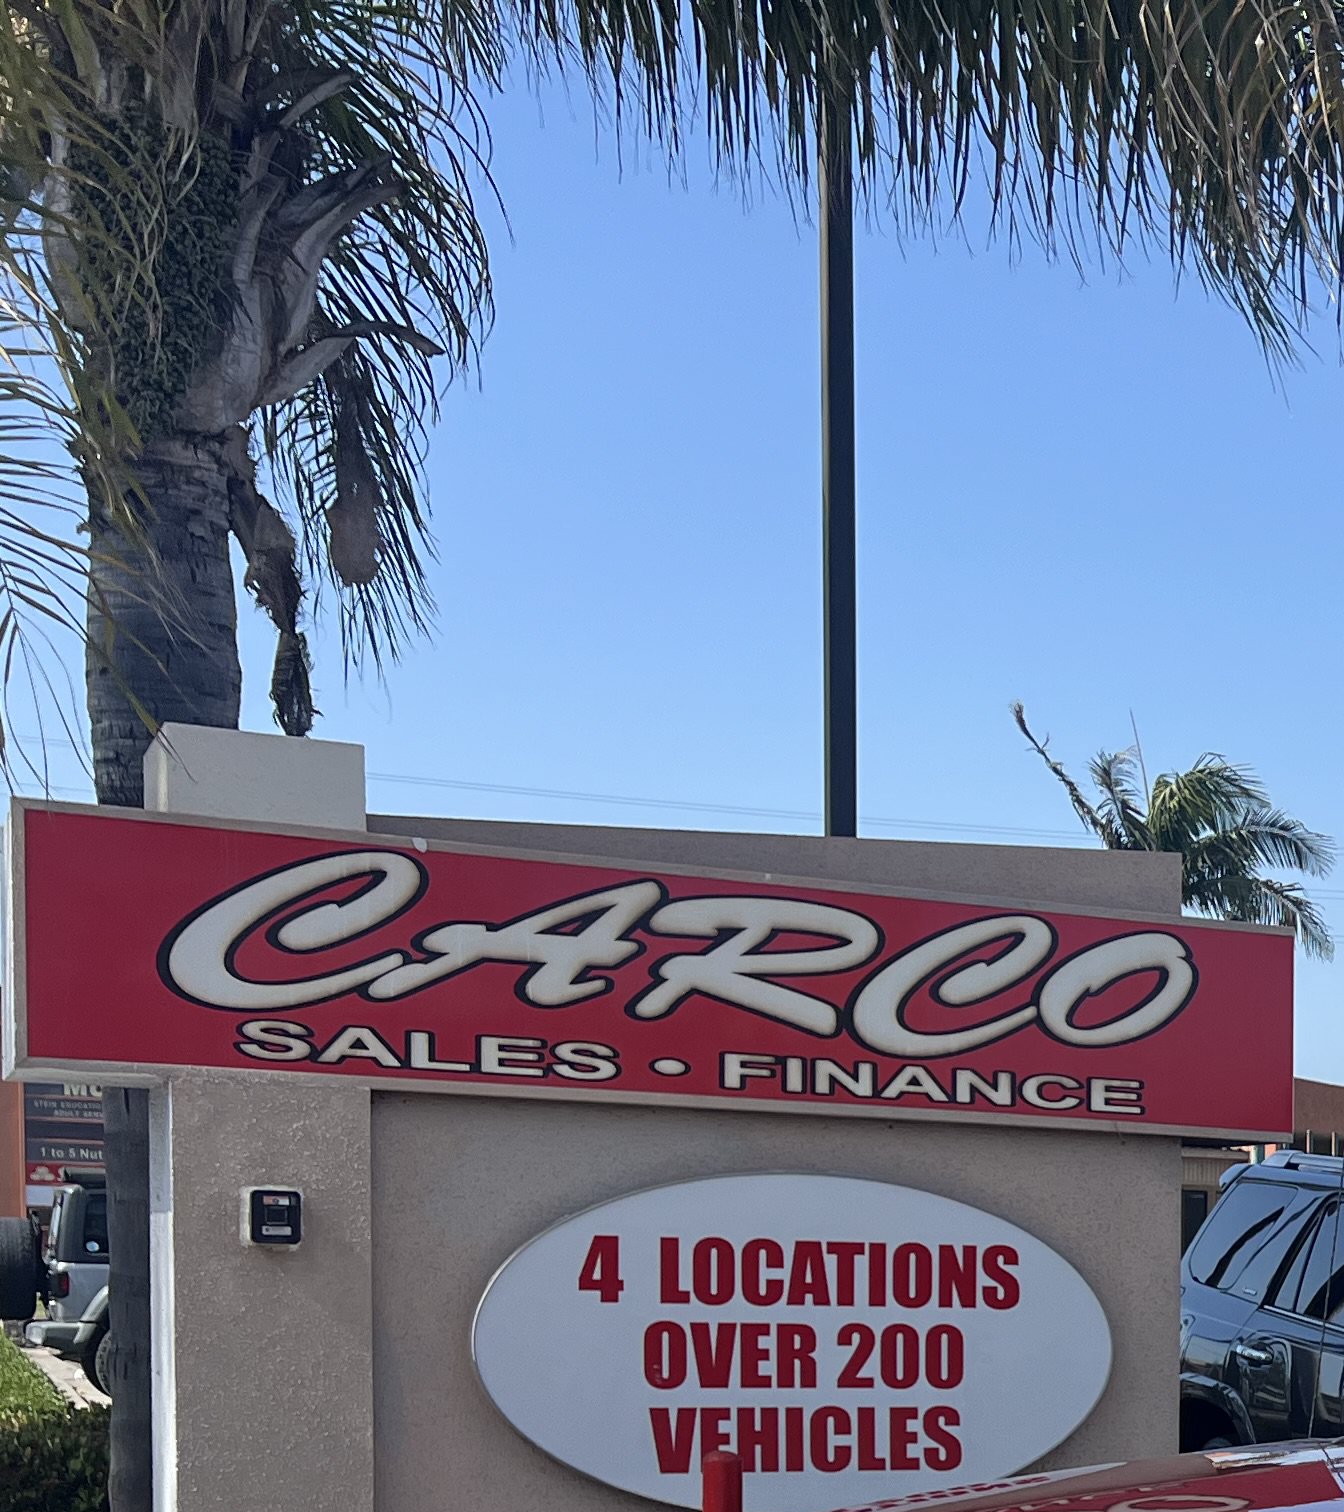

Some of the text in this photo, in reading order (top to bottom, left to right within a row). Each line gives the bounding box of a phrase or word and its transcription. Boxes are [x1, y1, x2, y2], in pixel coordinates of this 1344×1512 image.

[157, 849, 1198, 1059] CARCO
[236, 1019, 1146, 1116] SALES FINANCE
[51, 1147, 65, 1158] to
[578, 1235, 1021, 1311] 4 LOCATIONS
[642, 1320, 965, 1390] OVER 200
[649, 1405, 963, 1475] VEHICLES
